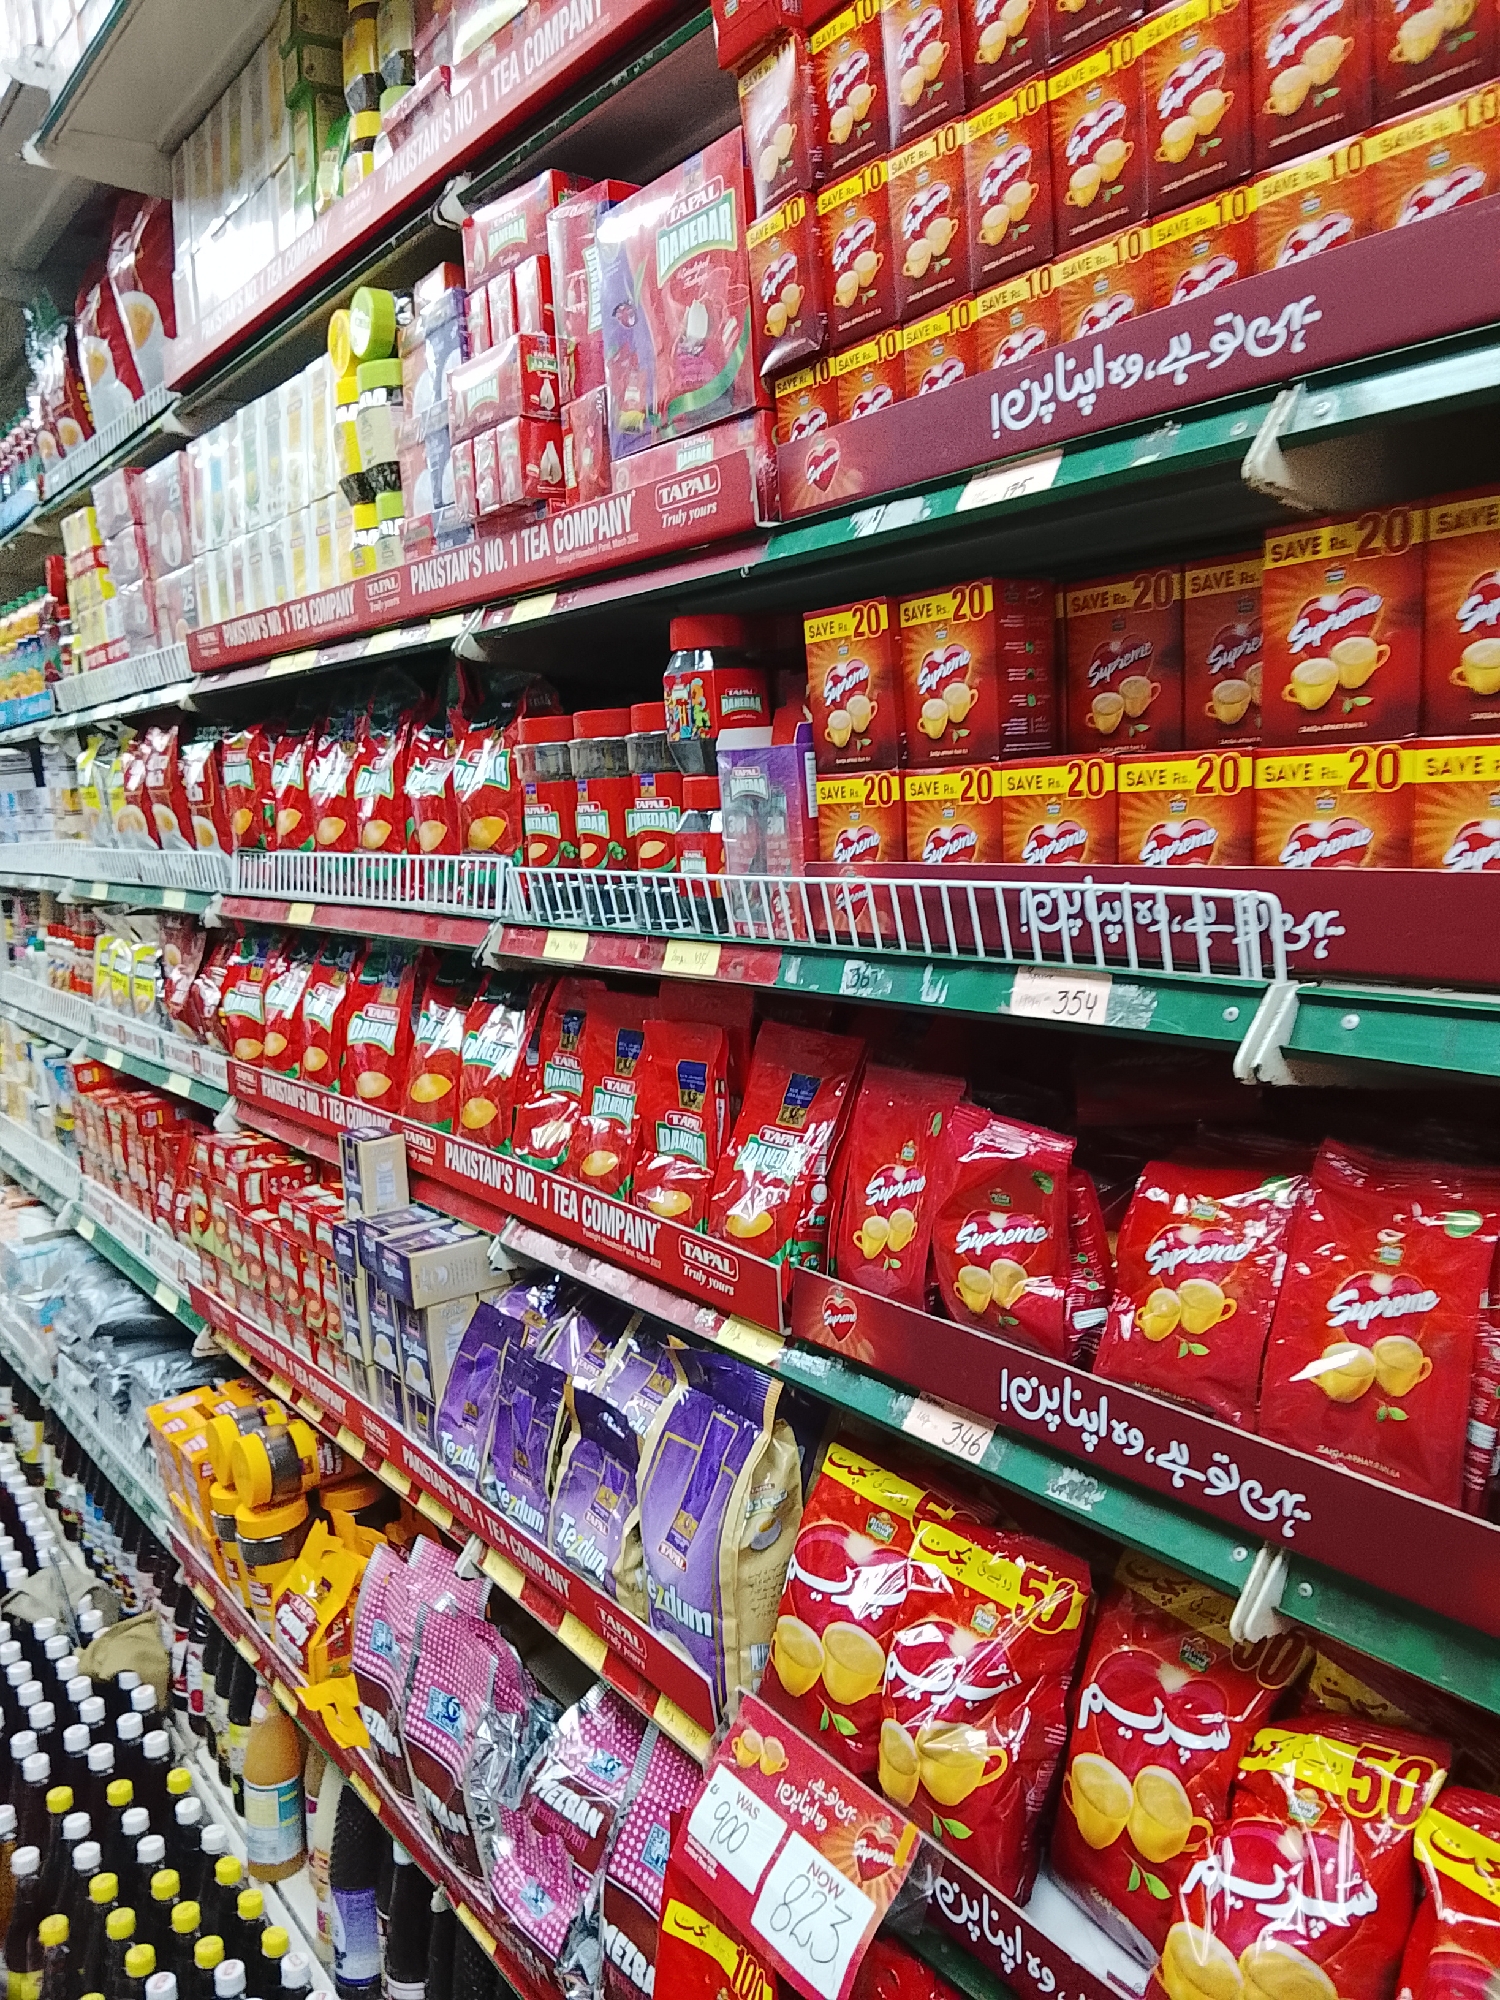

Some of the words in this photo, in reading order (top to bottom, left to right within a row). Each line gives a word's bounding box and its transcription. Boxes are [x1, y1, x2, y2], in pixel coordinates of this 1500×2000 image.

[1054, 68, 1086, 95] SAVE
[1106, 34, 1133, 68] 10
[385, 110, 451, 193] PAKISTAN'S
[455, 93, 478, 135] NO.
[491, 61, 522, 102] TEA
[891, 151, 916, 175] SAVE
[932, 123, 957, 157] 10
[669, 182, 720, 223] TAPAL
[659, 200, 733, 274] DANEDAR
[1062, 259, 1092, 279] SAVE
[1115, 227, 1141, 266] 10
[982, 292, 1008, 312] SAVE
[1027, 268, 1050, 300] 10
[838, 354, 861, 372] SAVE
[876, 331, 898, 363] 10
[658, 477, 717, 505] TAPAL
[661, 512, 687, 529] Truly
[688, 502, 718, 525] yours
[1271, 537, 1324, 562] SAVE
[1355, 508, 1412, 561] 20
[410, 546, 483, 595] PAKISTAN'S
[485, 541, 508, 574] NO.
[521, 532, 550, 561] TEA
[367, 578, 399, 596] TAPAL
[903, 605, 933, 622] SAVE
[952, 583, 985, 622] 20
[1072, 593, 1108, 612] SAVE
[1132, 571, 1174, 611] 20
[291, 602, 308, 631] TEA
[809, 620, 836, 639] SAVE
[852, 603, 882, 639] 20
[1287, 594, 1383, 653] Supreme
[917, 650, 971, 694] Supreme
[1088, 641, 1153, 688] Supreme
[722, 695, 763, 713] DANEDAR
[824, 664, 870, 706] Supreme
[910, 779, 941, 797] SAVE
[961, 767, 993, 802] 20
[1007, 773, 1044, 791] SAVE
[1067, 760, 1105, 799] 20
[1126, 764, 1167, 786] SAVE
[1196, 754, 1240, 795] 20
[1265, 762, 1314, 784] SAVE
[1348, 748, 1402, 792] 20
[635, 799, 667, 809] TAPAL
[820, 783, 847, 801] SAVE
[864, 774, 893, 807] 20
[833, 832, 881, 863] Supreme
[922, 829, 979, 863] Supreme
[1021, 828, 1089, 864] Supreme
[1140, 827, 1218, 866] Supreme
[1280, 827, 1374, 868] Supreme
[1052, 989, 1098, 1019] 354
[329, 1096, 347, 1127] TEA
[669, 1113, 702, 1133] TAPAL
[405, 1130, 434, 1151] TAPAL
[444, 1142, 514, 1193] PAKISTAN'S
[515, 1171, 539, 1206] NO.
[552, 1183, 580, 1222] TEA
[865, 1174, 927, 1206] Supreme
[682, 1240, 736, 1276] TAPAL
[955, 1222, 1048, 1256] Supreme
[1145, 1238, 1250, 1276] Supreme
[682, 1266, 707, 1287] Truly
[707, 1275, 735, 1296] yours
[1326, 1288, 1441, 1330] Supreme
[494, 1480, 545, 1534] Tezdum
[585, 1511, 609, 1536] TAPAL
[487, 1516, 510, 1549] TEA
[658, 1543, 687, 1572] TAPAL
[598, 1607, 644, 1653] TAPAL
[1078, 1681, 1231, 1765] سپریم
[736, 1790, 761, 1820] WAS
[1345, 1742, 1438, 1828] 50
[530, 1779, 604, 1838] MEZBAN
[709, 1800, 750, 1854] 900
[806, 1859, 846, 1899] NOW
[769, 1873, 853, 1964] 823
[602, 1920, 656, 1997] MEZBA
